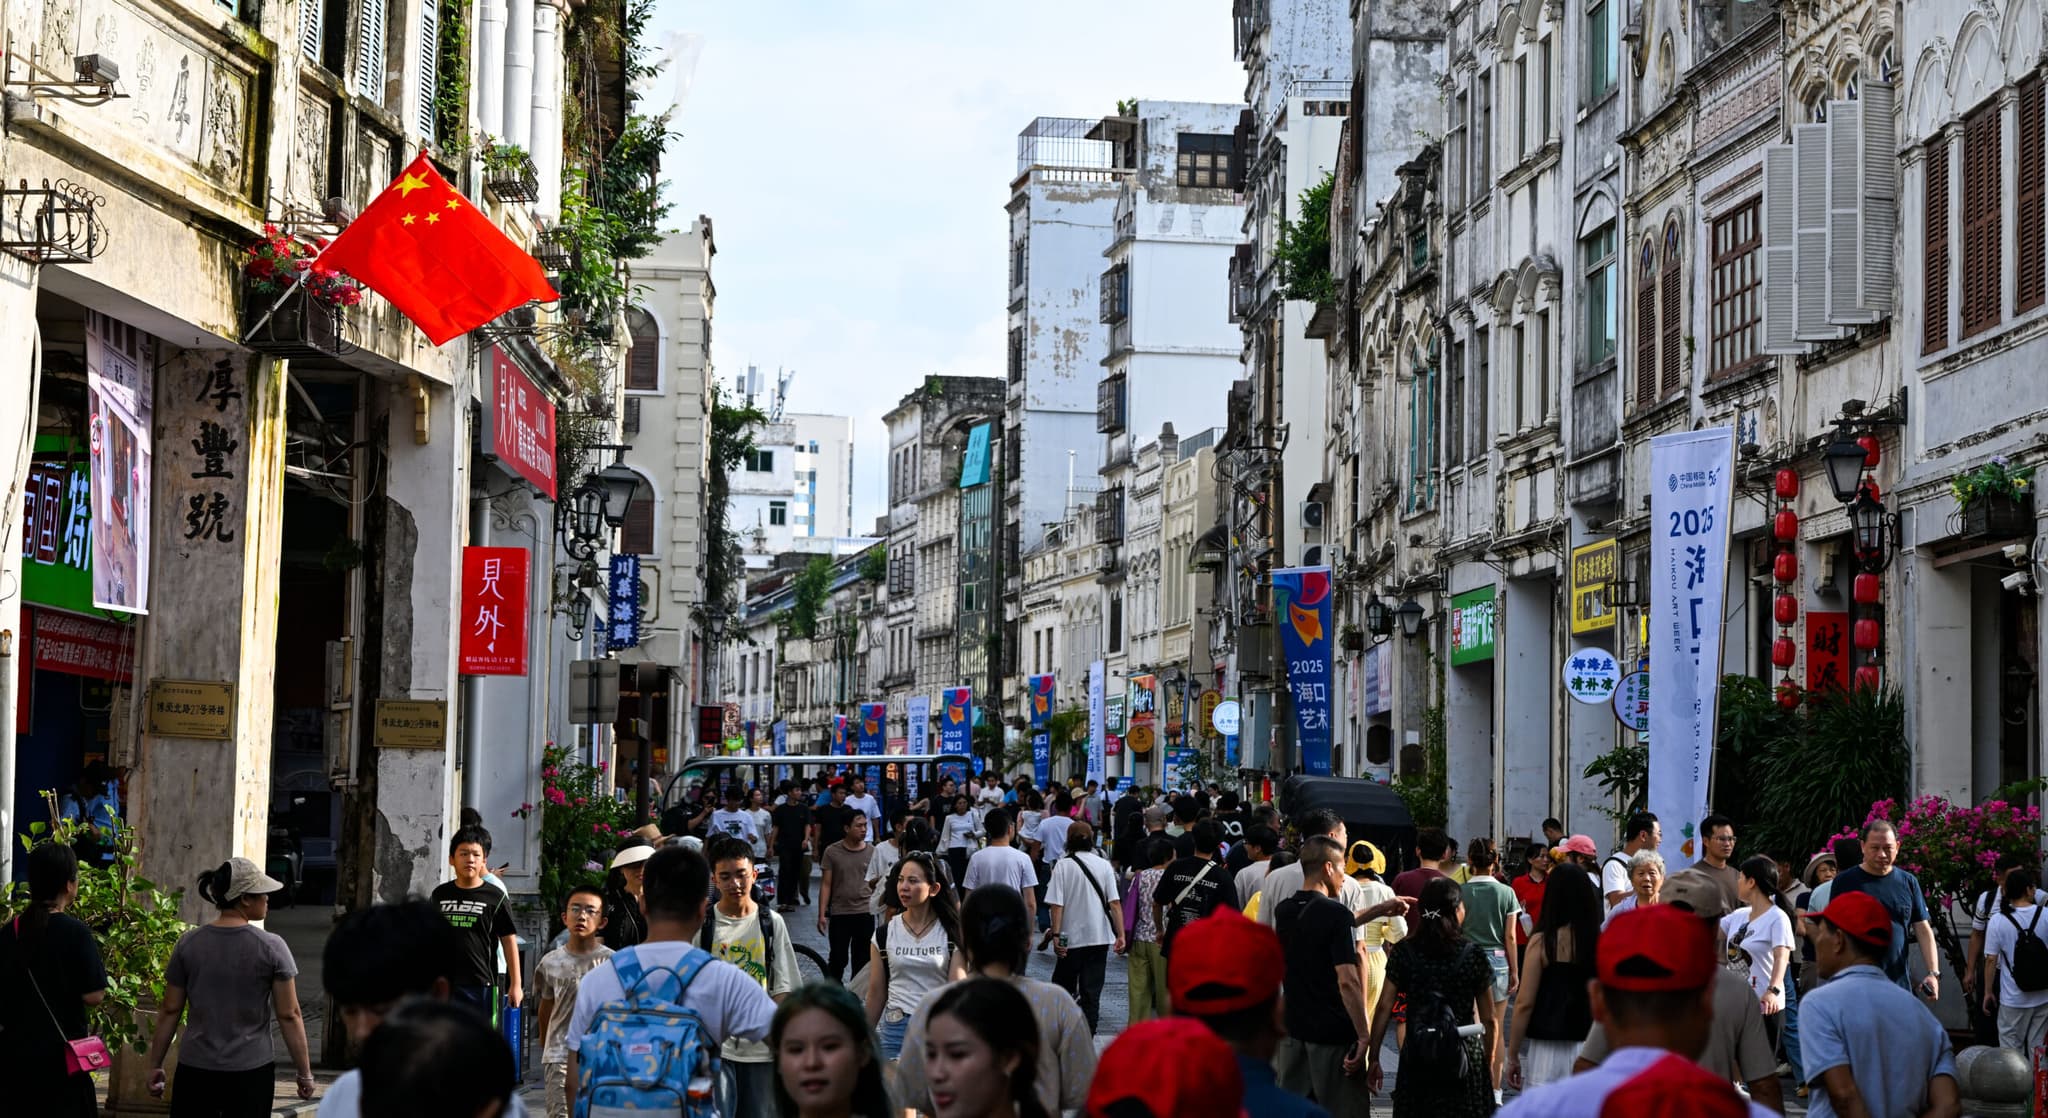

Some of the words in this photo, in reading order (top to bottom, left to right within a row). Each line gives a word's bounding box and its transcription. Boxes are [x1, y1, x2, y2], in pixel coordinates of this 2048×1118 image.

[184, 358, 242, 543] 厚豐號
[1670, 505, 1714, 538] 2025
[474, 558, 505, 641] 見外
[1671, 596, 1679, 618] ART
[1673, 622, 1681, 653] WEEK
[1292, 660, 1324, 674] 2025
[1296, 682, 1326, 703] 海口
[1570, 675, 1615, 691] 清补凉
[944, 731, 963, 739] 2025
[944, 741, 962, 752] 海口
[895, 946, 942, 956] CULTURE
